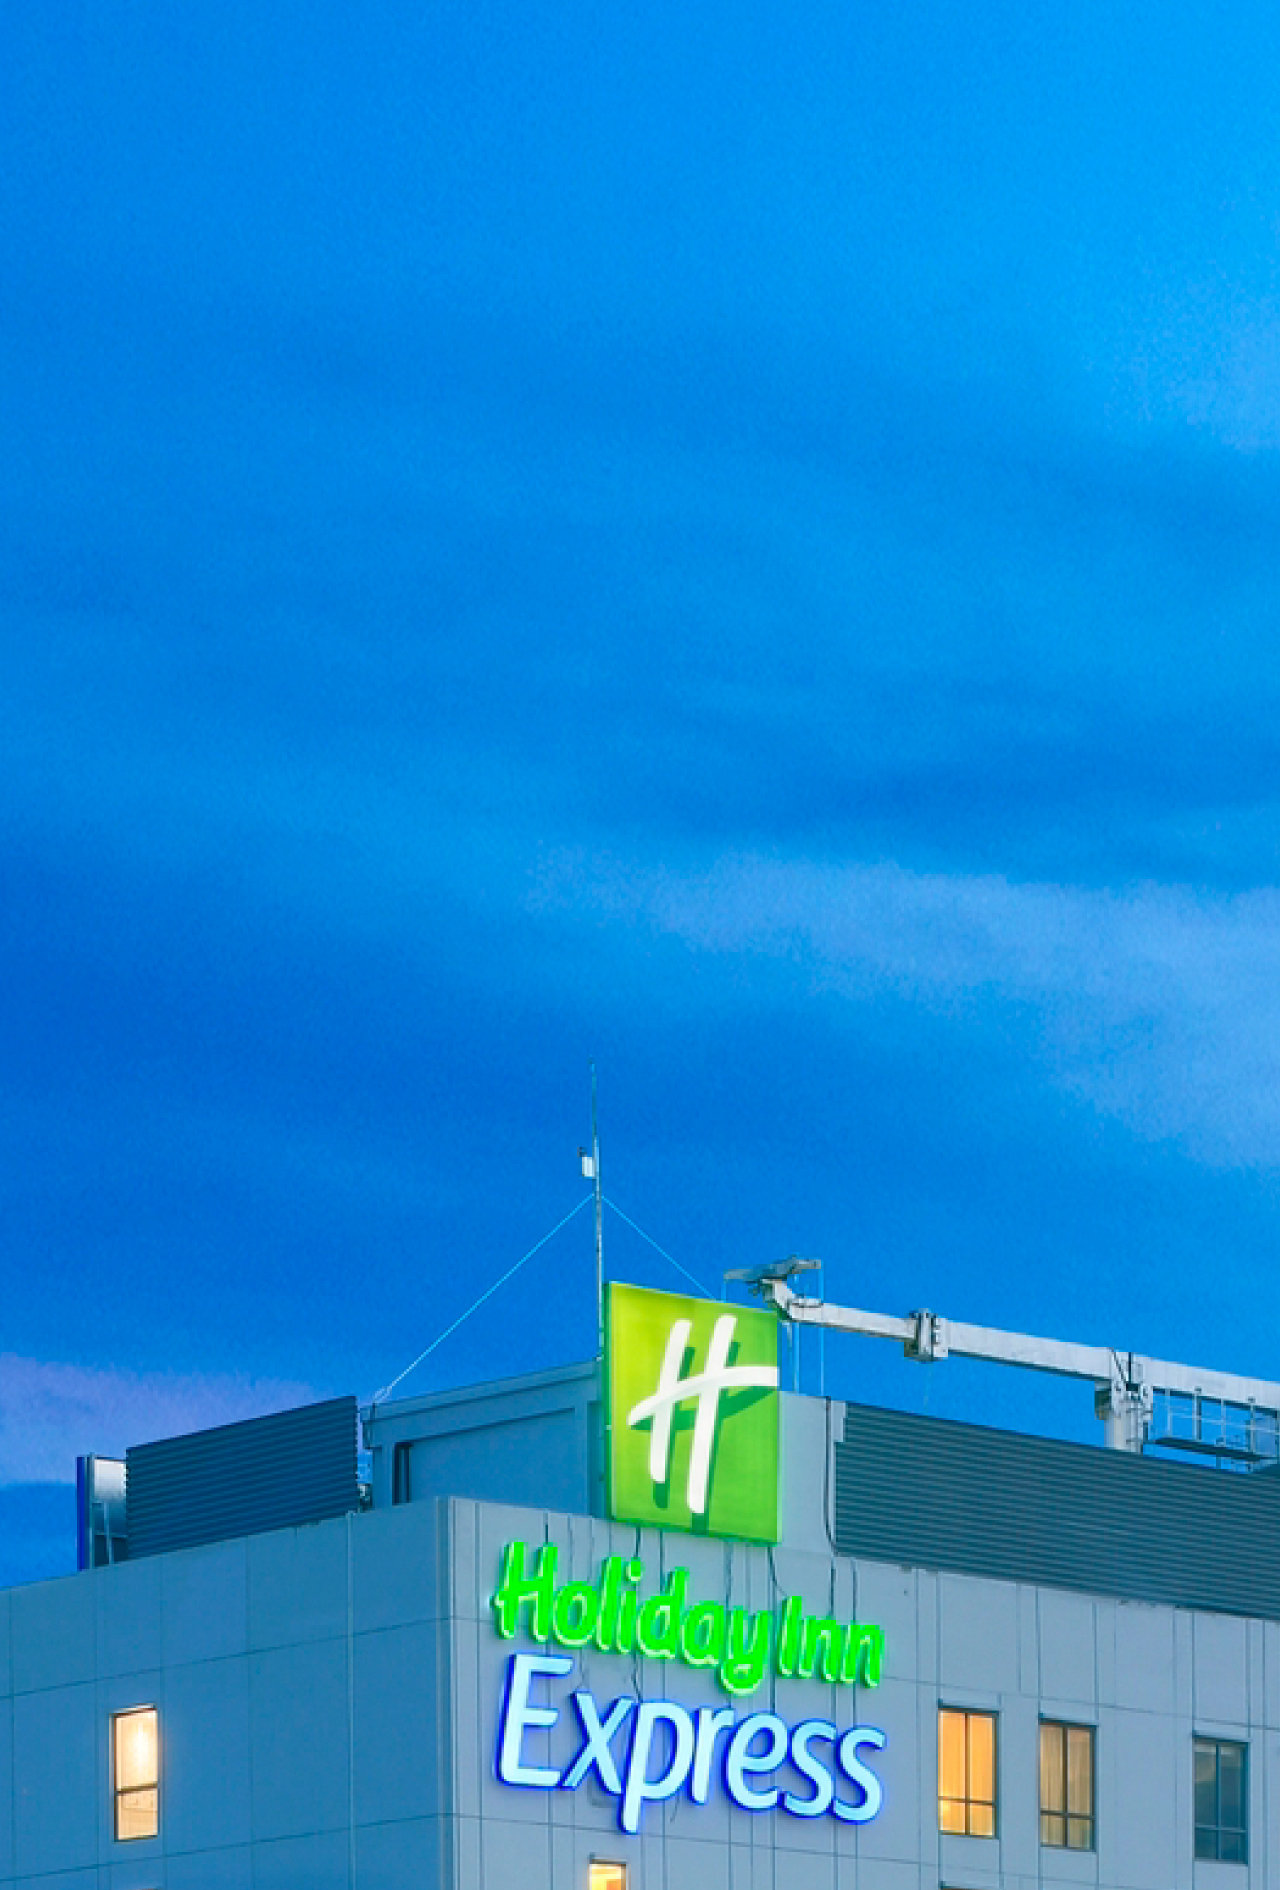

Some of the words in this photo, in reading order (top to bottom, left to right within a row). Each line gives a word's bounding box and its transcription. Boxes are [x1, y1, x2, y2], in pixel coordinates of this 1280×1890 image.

[491, 1541, 769, 1695] Holiday
[777, 1595, 885, 1688] Inn
[495, 1653, 887, 1836] Express
